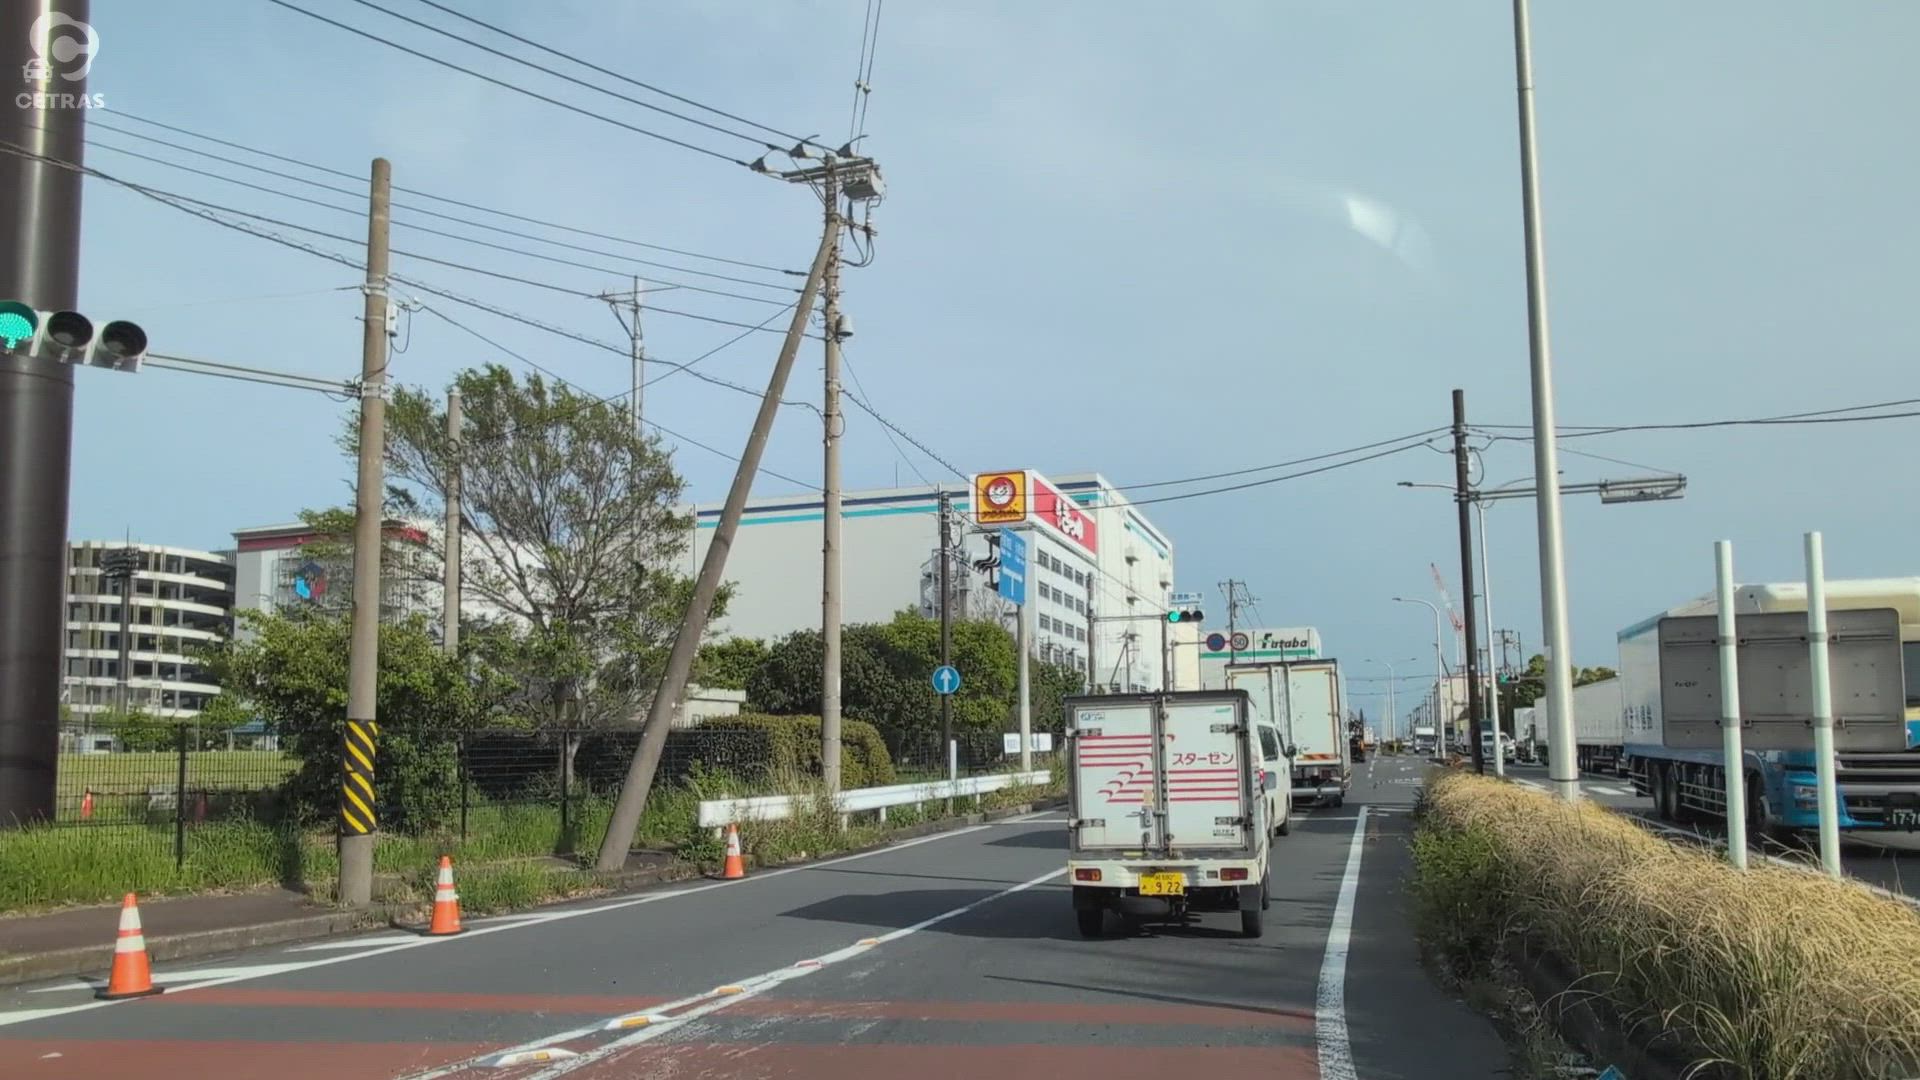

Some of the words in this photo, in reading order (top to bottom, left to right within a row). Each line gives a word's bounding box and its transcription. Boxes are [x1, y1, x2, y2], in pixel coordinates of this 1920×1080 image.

[1261, 632, 1308, 649] Futaba
[1172, 752, 1235, 766] スターゼン
